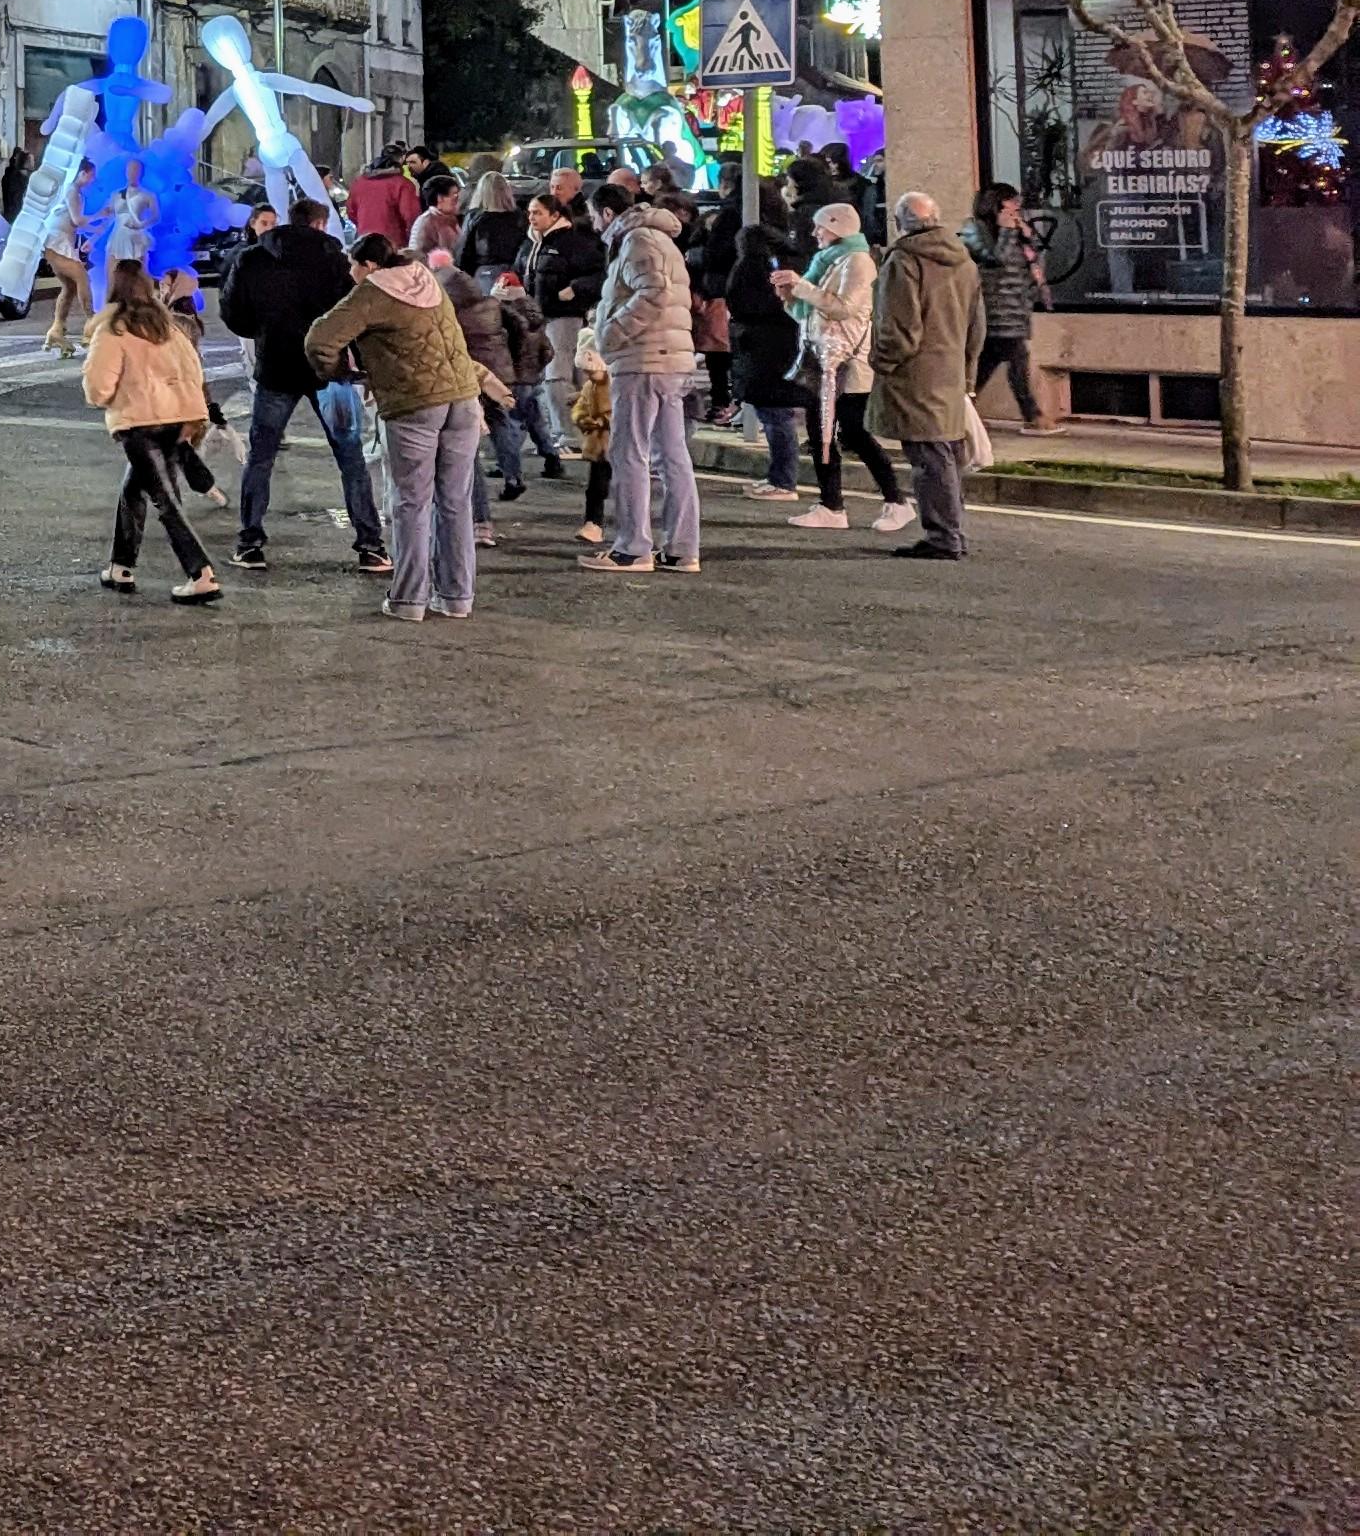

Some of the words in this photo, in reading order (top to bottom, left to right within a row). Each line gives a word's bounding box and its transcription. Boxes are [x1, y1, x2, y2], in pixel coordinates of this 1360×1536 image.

[1090, 146, 1137, 172] ¿QUÉ
[1139, 149, 1212, 169] SEGURO
[1108, 171, 1208, 193] ELEGIRÍAS?
[1110, 206, 1191, 215] JUBILACIÓN
[1109, 218, 1168, 228] AHORRO
[1110, 231, 1156, 240] SALUD
